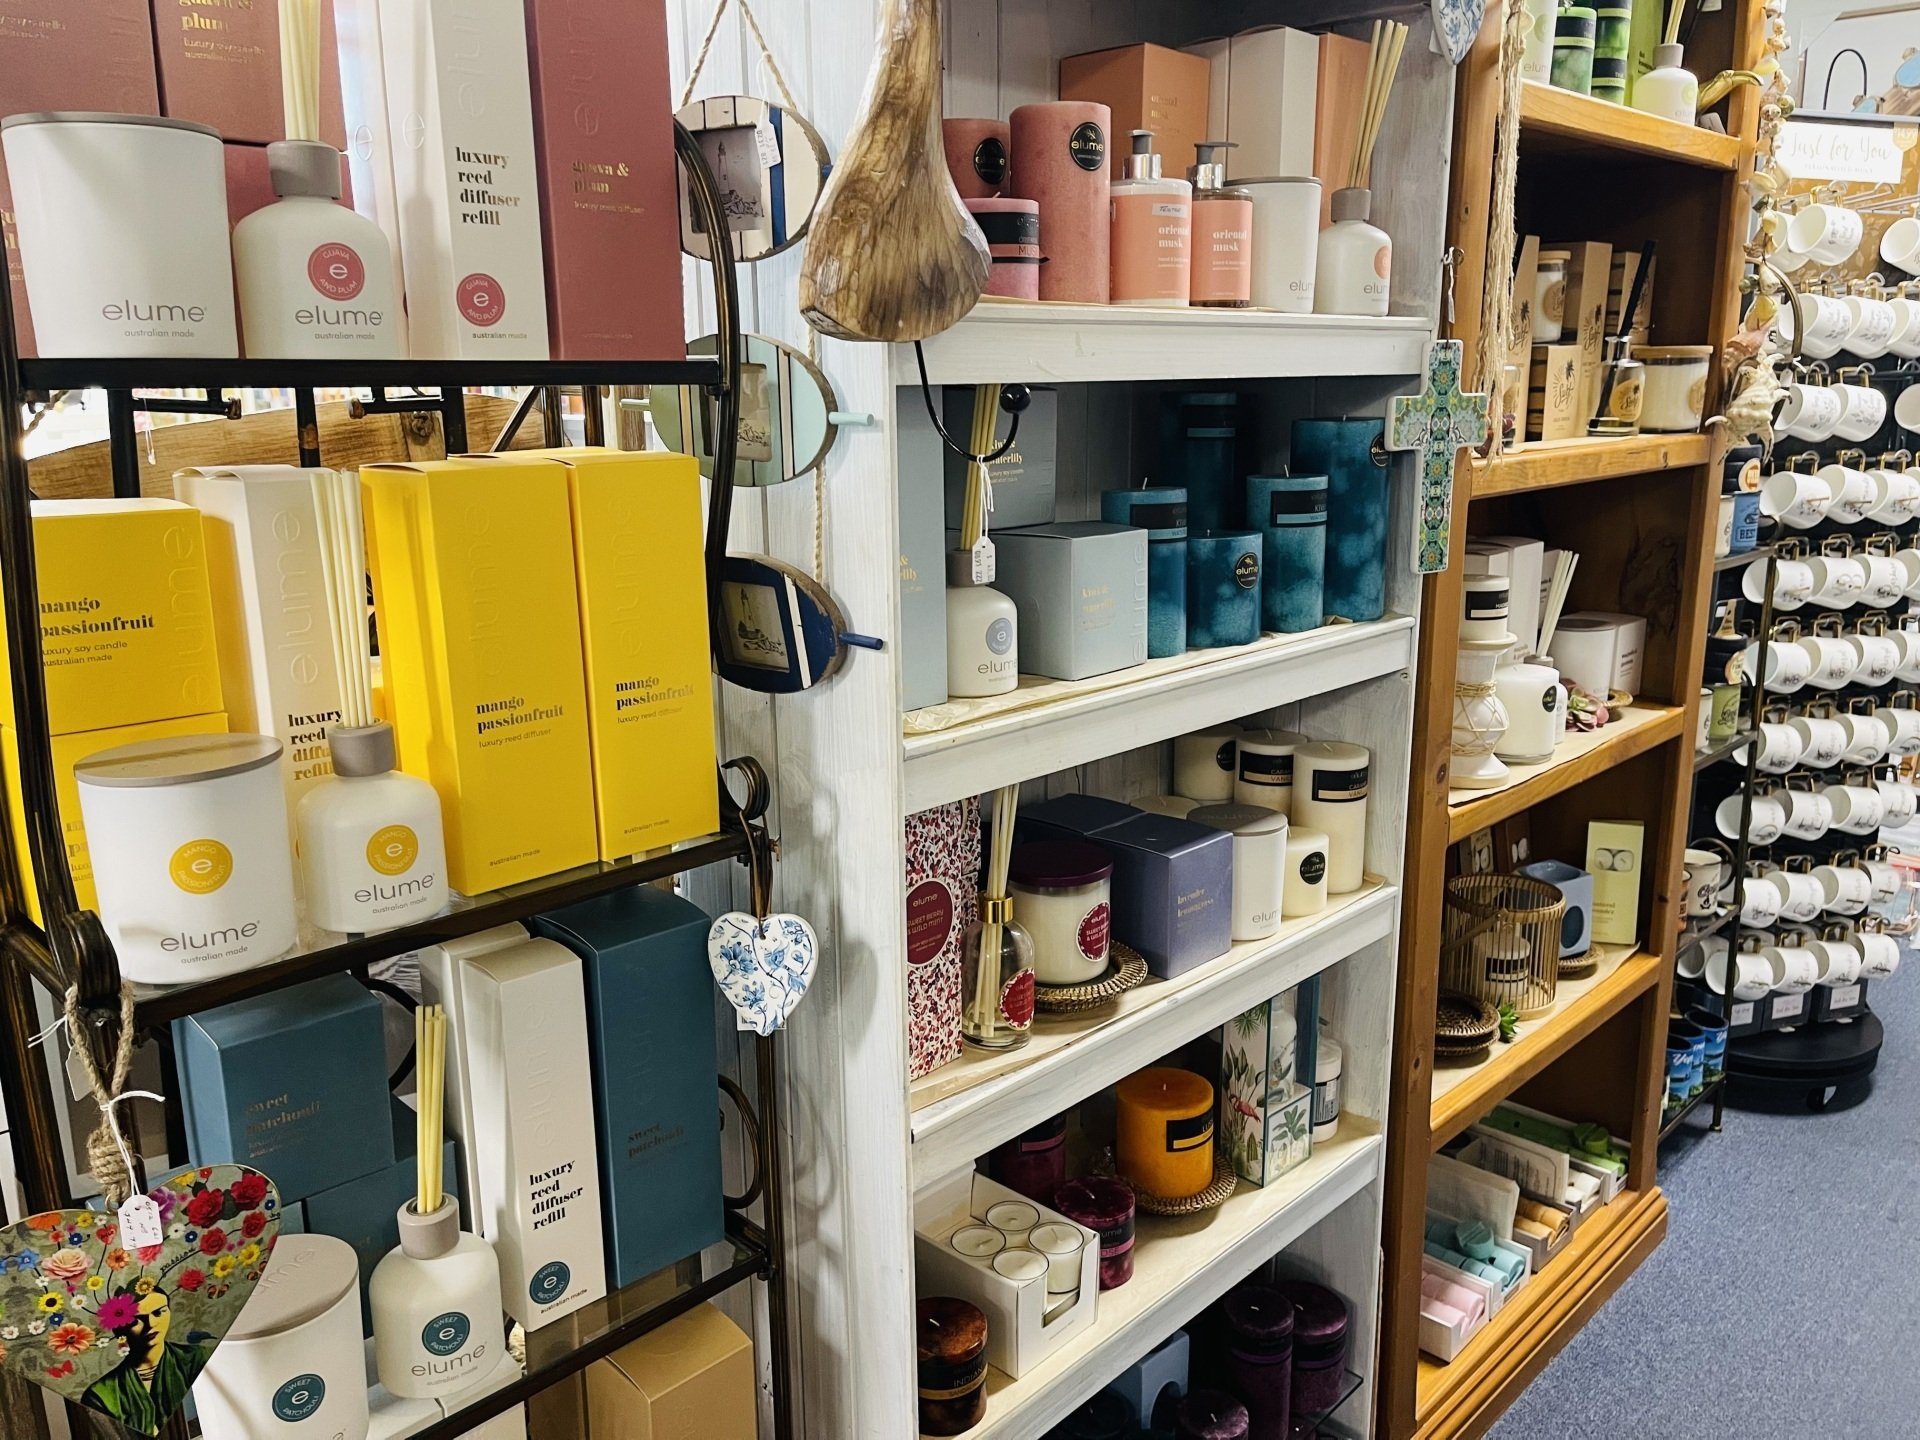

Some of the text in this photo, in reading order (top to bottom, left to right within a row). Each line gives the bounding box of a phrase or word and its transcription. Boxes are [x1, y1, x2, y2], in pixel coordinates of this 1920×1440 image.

[1071, 139, 1104, 152] elume
[1791, 131, 1891, 166] Just for You
[456, 147, 509, 169] luxury
[458, 170, 493, 185] reed
[460, 189, 521, 208] diffuser
[462, 210, 501, 226] refill
[1018, 246, 1039, 257] MUS
[1158, 238, 1184, 249] musk
[1212, 242, 1240, 252] musk
[322, 248, 351, 261] GUAVA
[319, 278, 358, 294] AND PLUM
[102, 300, 207, 323] elume
[295, 305, 383, 326] elume
[124, 328, 195, 339] australian made
[314, 331, 375, 341] australian made
[472, 331, 507, 339] australian
[41, 615, 154, 641] passionfruit
[42, 641, 128, 656] uxury soy candle
[87, 653, 113, 663] made
[616, 676, 660, 692] mango
[476, 696, 525, 714] mango
[616, 683, 695, 711] passionfruit
[288, 709, 342, 727] luxury
[477, 704, 564, 734] passionfruit
[617, 714, 640, 724] luxury
[641, 711, 657, 720] reed
[290, 727, 327, 745] reed
[479, 728, 552, 748] luxury reed diffuser
[292, 745, 331, 763] diffu
[354, 873, 435, 903] elume
[372, 902, 409, 914] australian
[912, 894, 938, 907] elume
[160, 921, 259, 952] elume
[181, 945, 249, 964] australian made
[530, 1160, 575, 1186] luxury
[531, 1179, 560, 1201] reed
[532, 1187, 583, 1216] diffuser
[533, 1207, 566, 1231] refill
[538, 1265, 560, 1279] SWEET
[540, 1288, 588, 1314] australian made
[433, 1316, 459, 1328] SWEET
[411, 1344, 486, 1376] elume
[284, 1379, 312, 1393] SWEET
[282, 1395, 320, 1416] PATCHOULI
